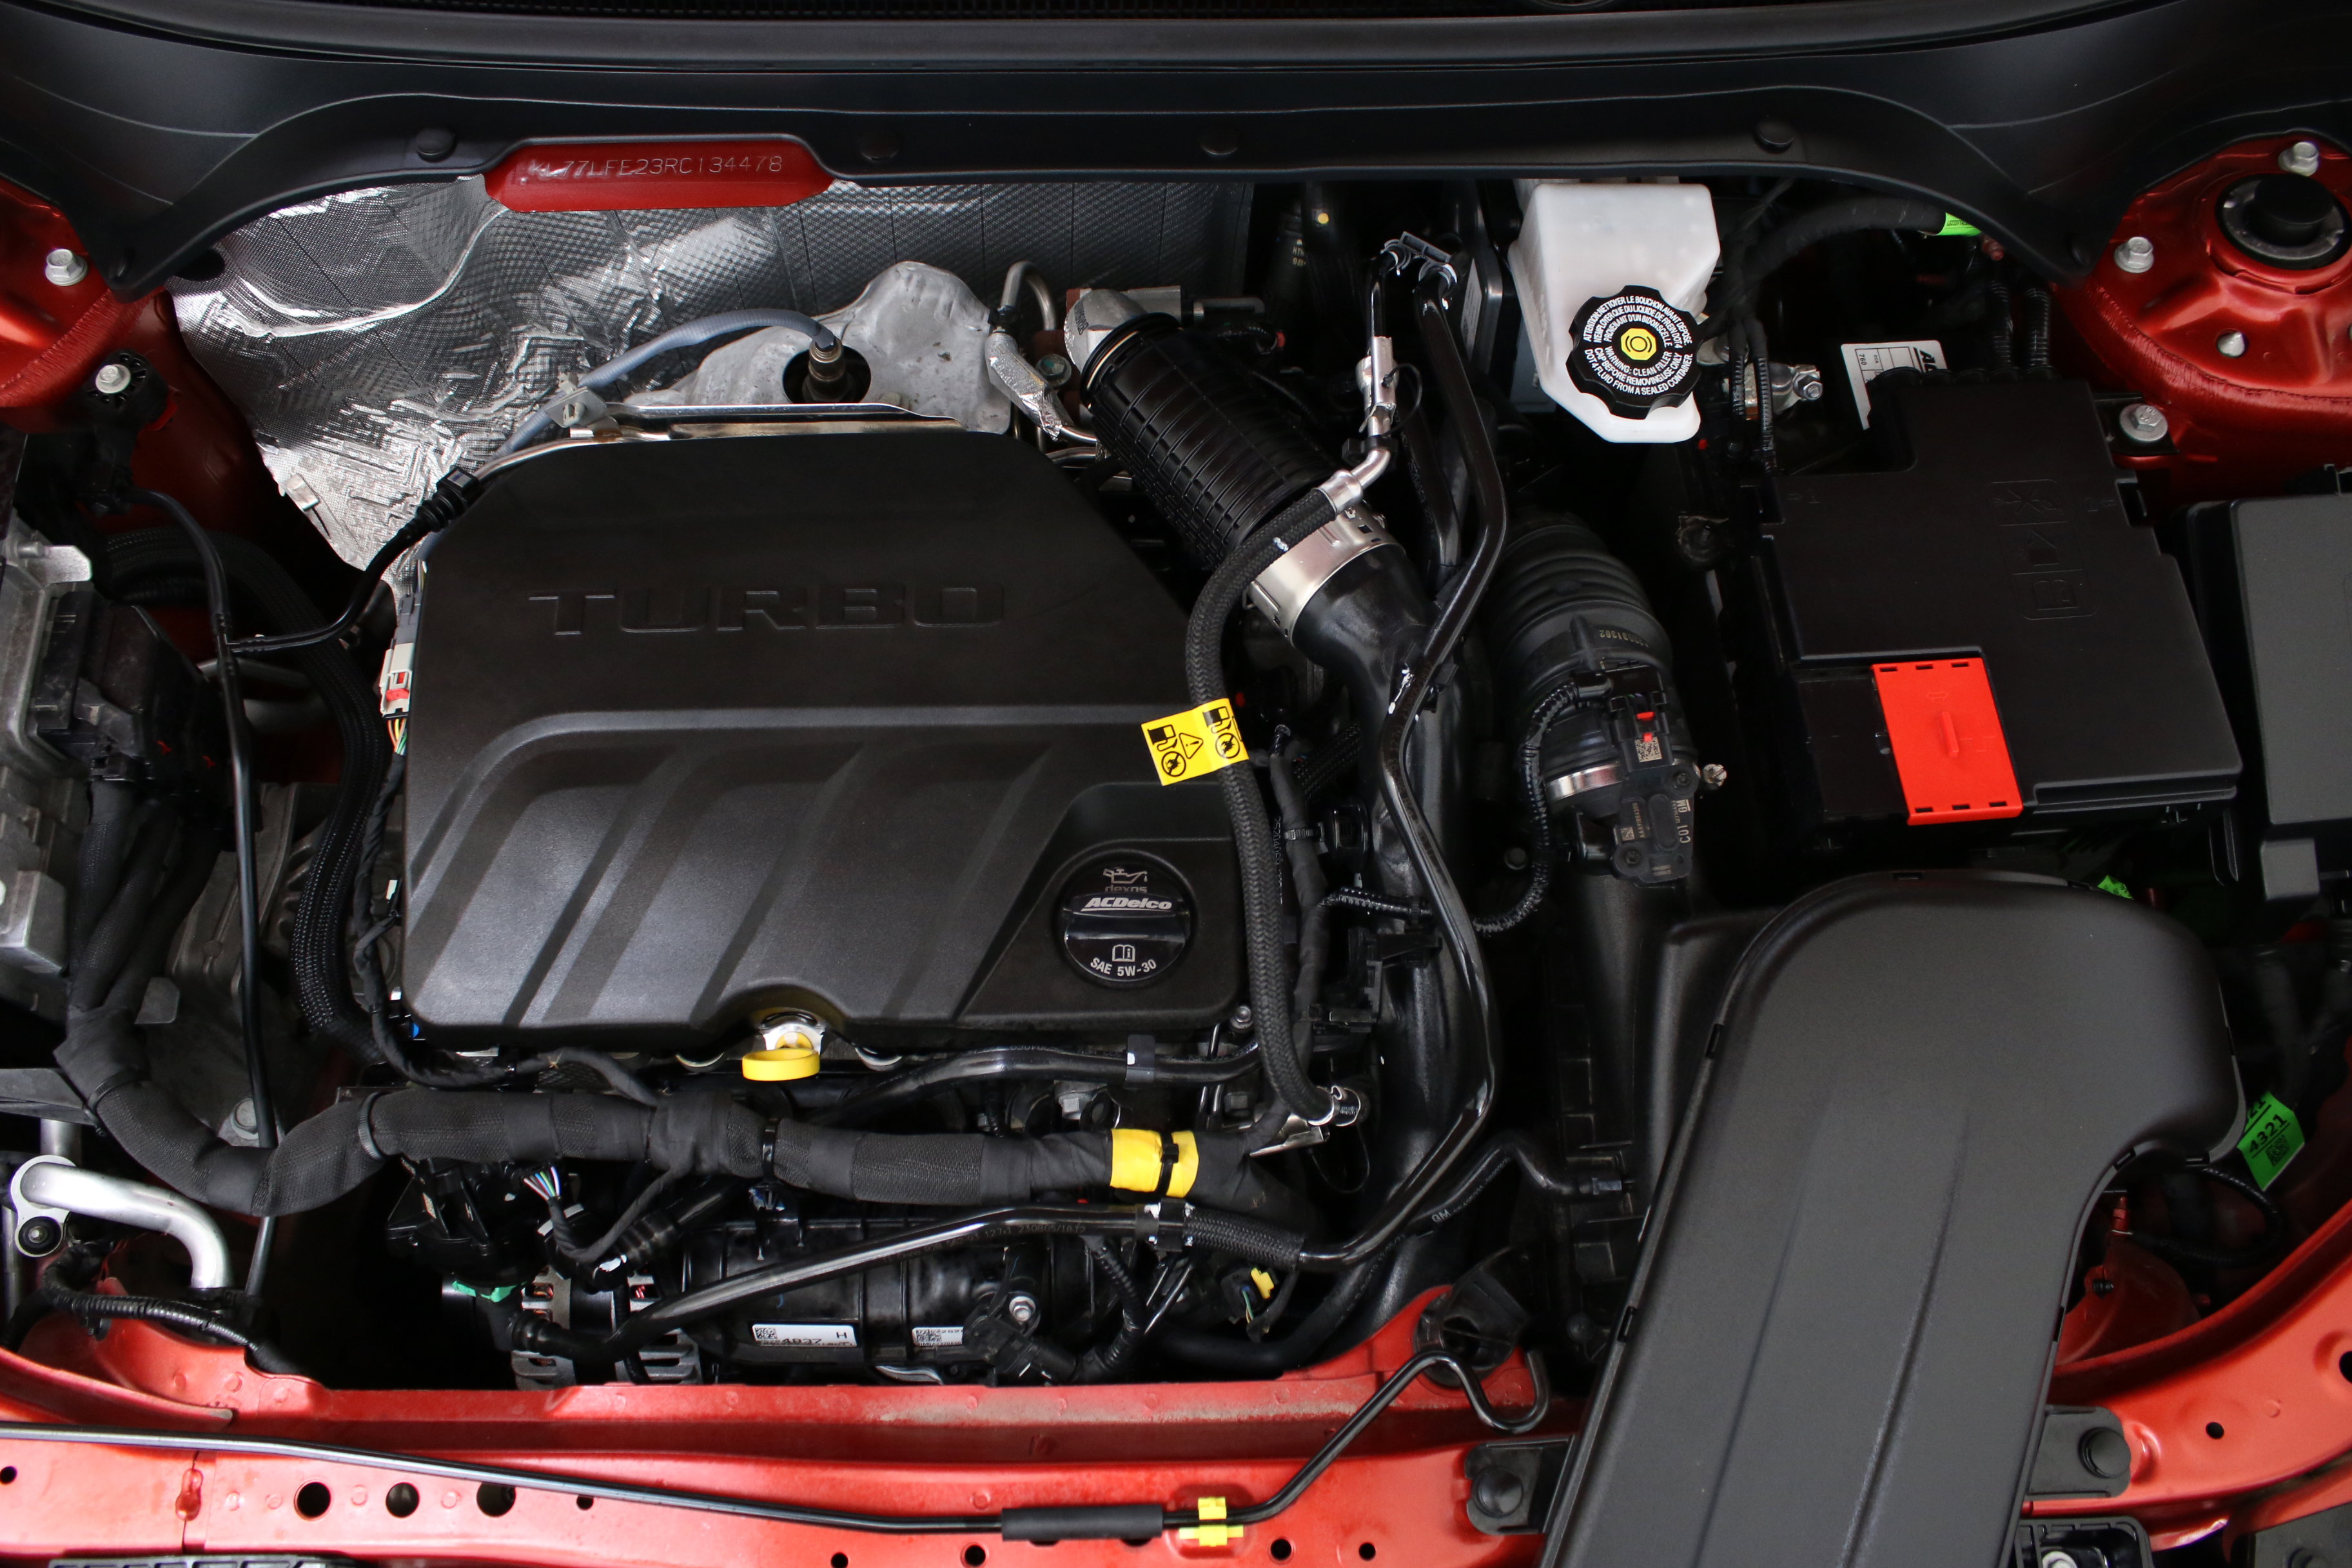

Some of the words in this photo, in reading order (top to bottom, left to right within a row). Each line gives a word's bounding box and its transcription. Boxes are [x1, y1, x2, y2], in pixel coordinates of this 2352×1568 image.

[1596, 297, 1626, 317] NETTOYER
[1635, 296, 1664, 311] BOUCHON
[1661, 306, 1681, 324] AVANT
[1611, 306, 1625, 317] QUE
[1623, 305, 1632, 313] DU
[1632, 305, 1656, 317] LIQUIDE
[1654, 311, 1665, 322] DE
[1661, 317, 1678, 334] FREIN
[1603, 315, 1628, 342] PROVENANT
[1642, 315, 1660, 329] BIDON
[1594, 347, 1607, 361] CAP
[1601, 360, 1627, 382] BEFORE
[1626, 374, 1664, 386] REMOVING
[1660, 366, 1675, 380] USE
[1669, 352, 1683, 370] ONLY
[1594, 366, 1614, 384] FLUID
[1612, 380, 1634, 394] FROM
[1634, 387, 1641, 395] A
[1641, 382, 1669, 395] SEALED
[1667, 353, 1693, 387] CONTAINER.
[1605, 346, 1632, 375] WARNING:
[1632, 366, 1657, 377] CLEAN
[1654, 351, 1672, 371] FILLER
[528, 583, 1004, 635] TURBO
[1678, 799, 1687, 812] GM
[1084, 897, 1173, 910] ACDelco
[1090, 957, 1112, 975] SAE
[1117, 959, 1157, 977] 5W-30
[2249, 1114, 2288, 1152] 4321
[1432, 1208, 1451, 1223] GM
